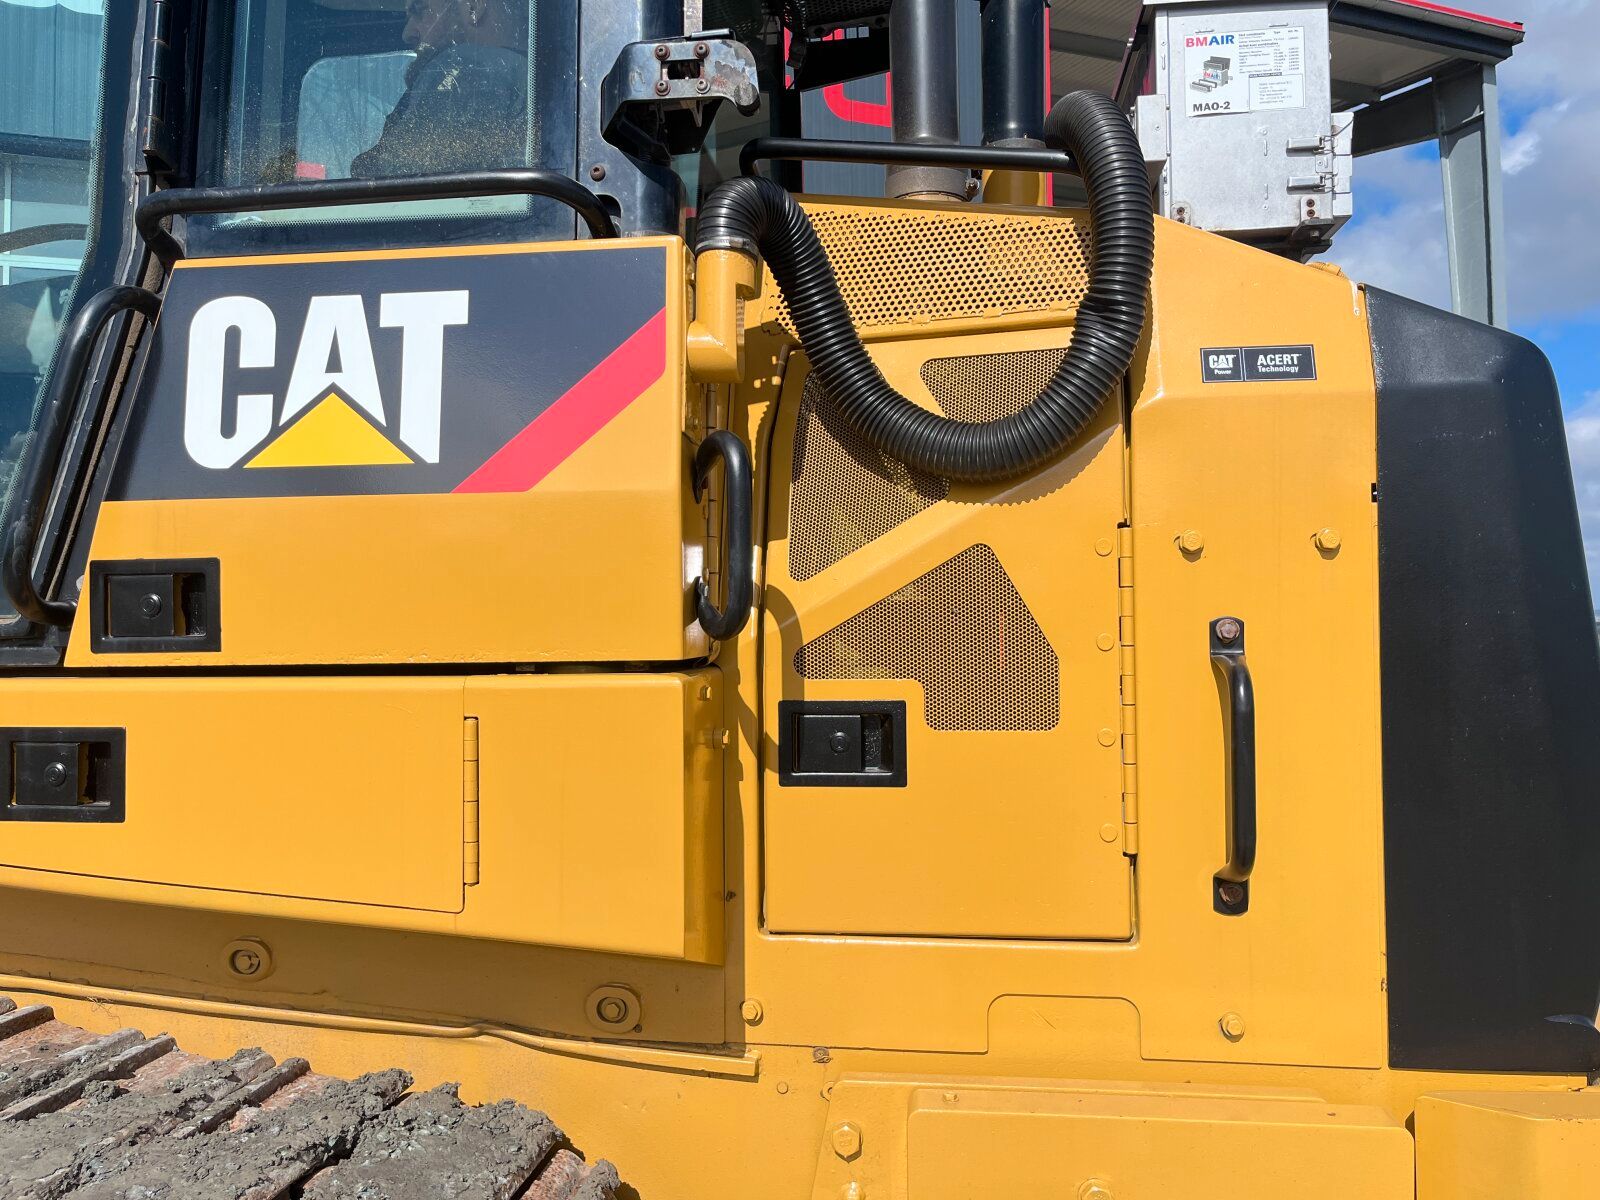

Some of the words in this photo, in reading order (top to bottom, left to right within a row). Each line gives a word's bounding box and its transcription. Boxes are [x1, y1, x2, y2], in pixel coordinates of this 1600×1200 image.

[1186, 35, 1235, 48] BMAIR
[1193, 101, 1231, 112] MAO-2
[1208, 354, 1234, 369] CAT
[1257, 353, 1300, 365] ACERT
[1257, 365, 1299, 373] Technology
[183, 289, 470, 469] CAT
